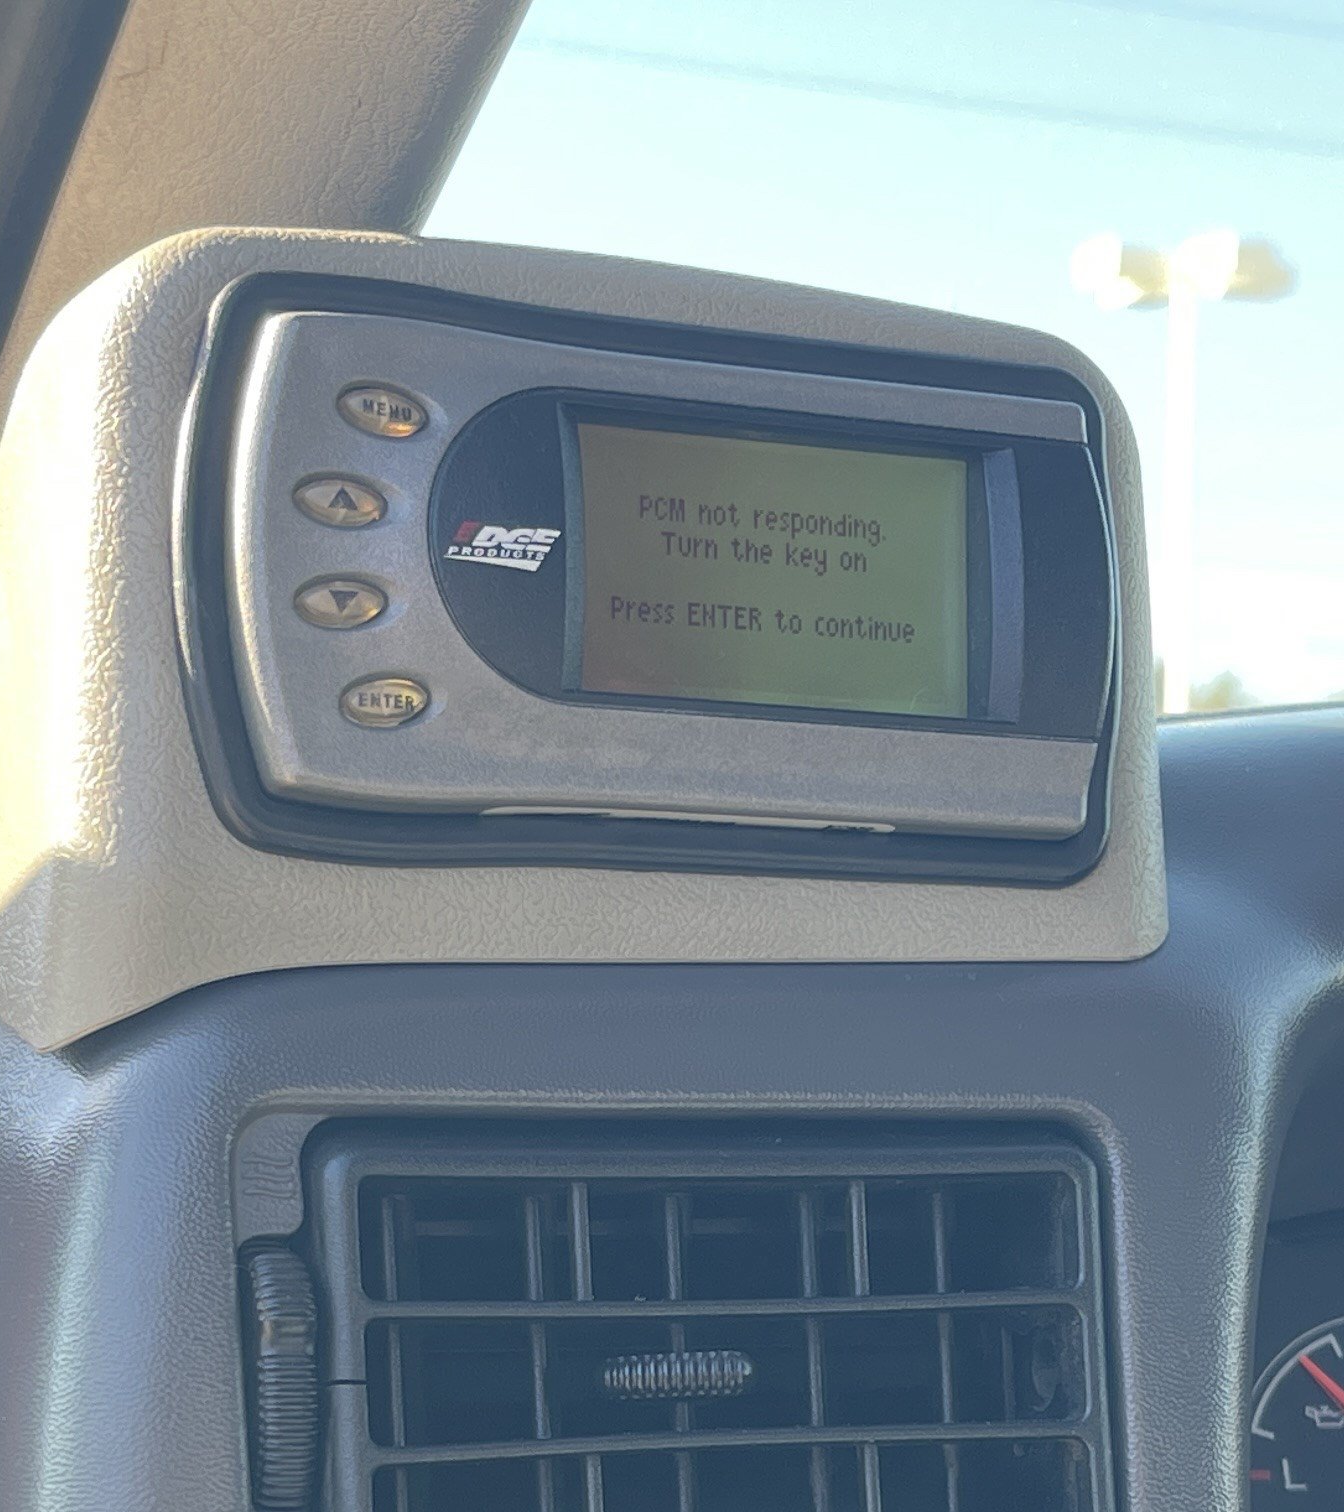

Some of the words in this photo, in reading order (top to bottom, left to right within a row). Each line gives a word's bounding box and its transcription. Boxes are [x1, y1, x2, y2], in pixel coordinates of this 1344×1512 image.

[362, 398, 412, 421] MENU
[639, 495, 685, 523] PCM
[698, 502, 740, 529] not
[753, 507, 887, 547] responding.
[447, 545, 545, 561] PRODUCTS
[661, 530, 718, 560] Turn
[731, 536, 773, 565] the
[785, 542, 828, 577] key
[839, 550, 867, 573] on
[610, 595, 675, 625] Press
[687, 601, 763, 631] ENTER
[774, 608, 802, 635] to
[814, 614, 916, 644] continue
[357, 691, 415, 712] ENTER
[1281, 1457, 1307, 1491] L
